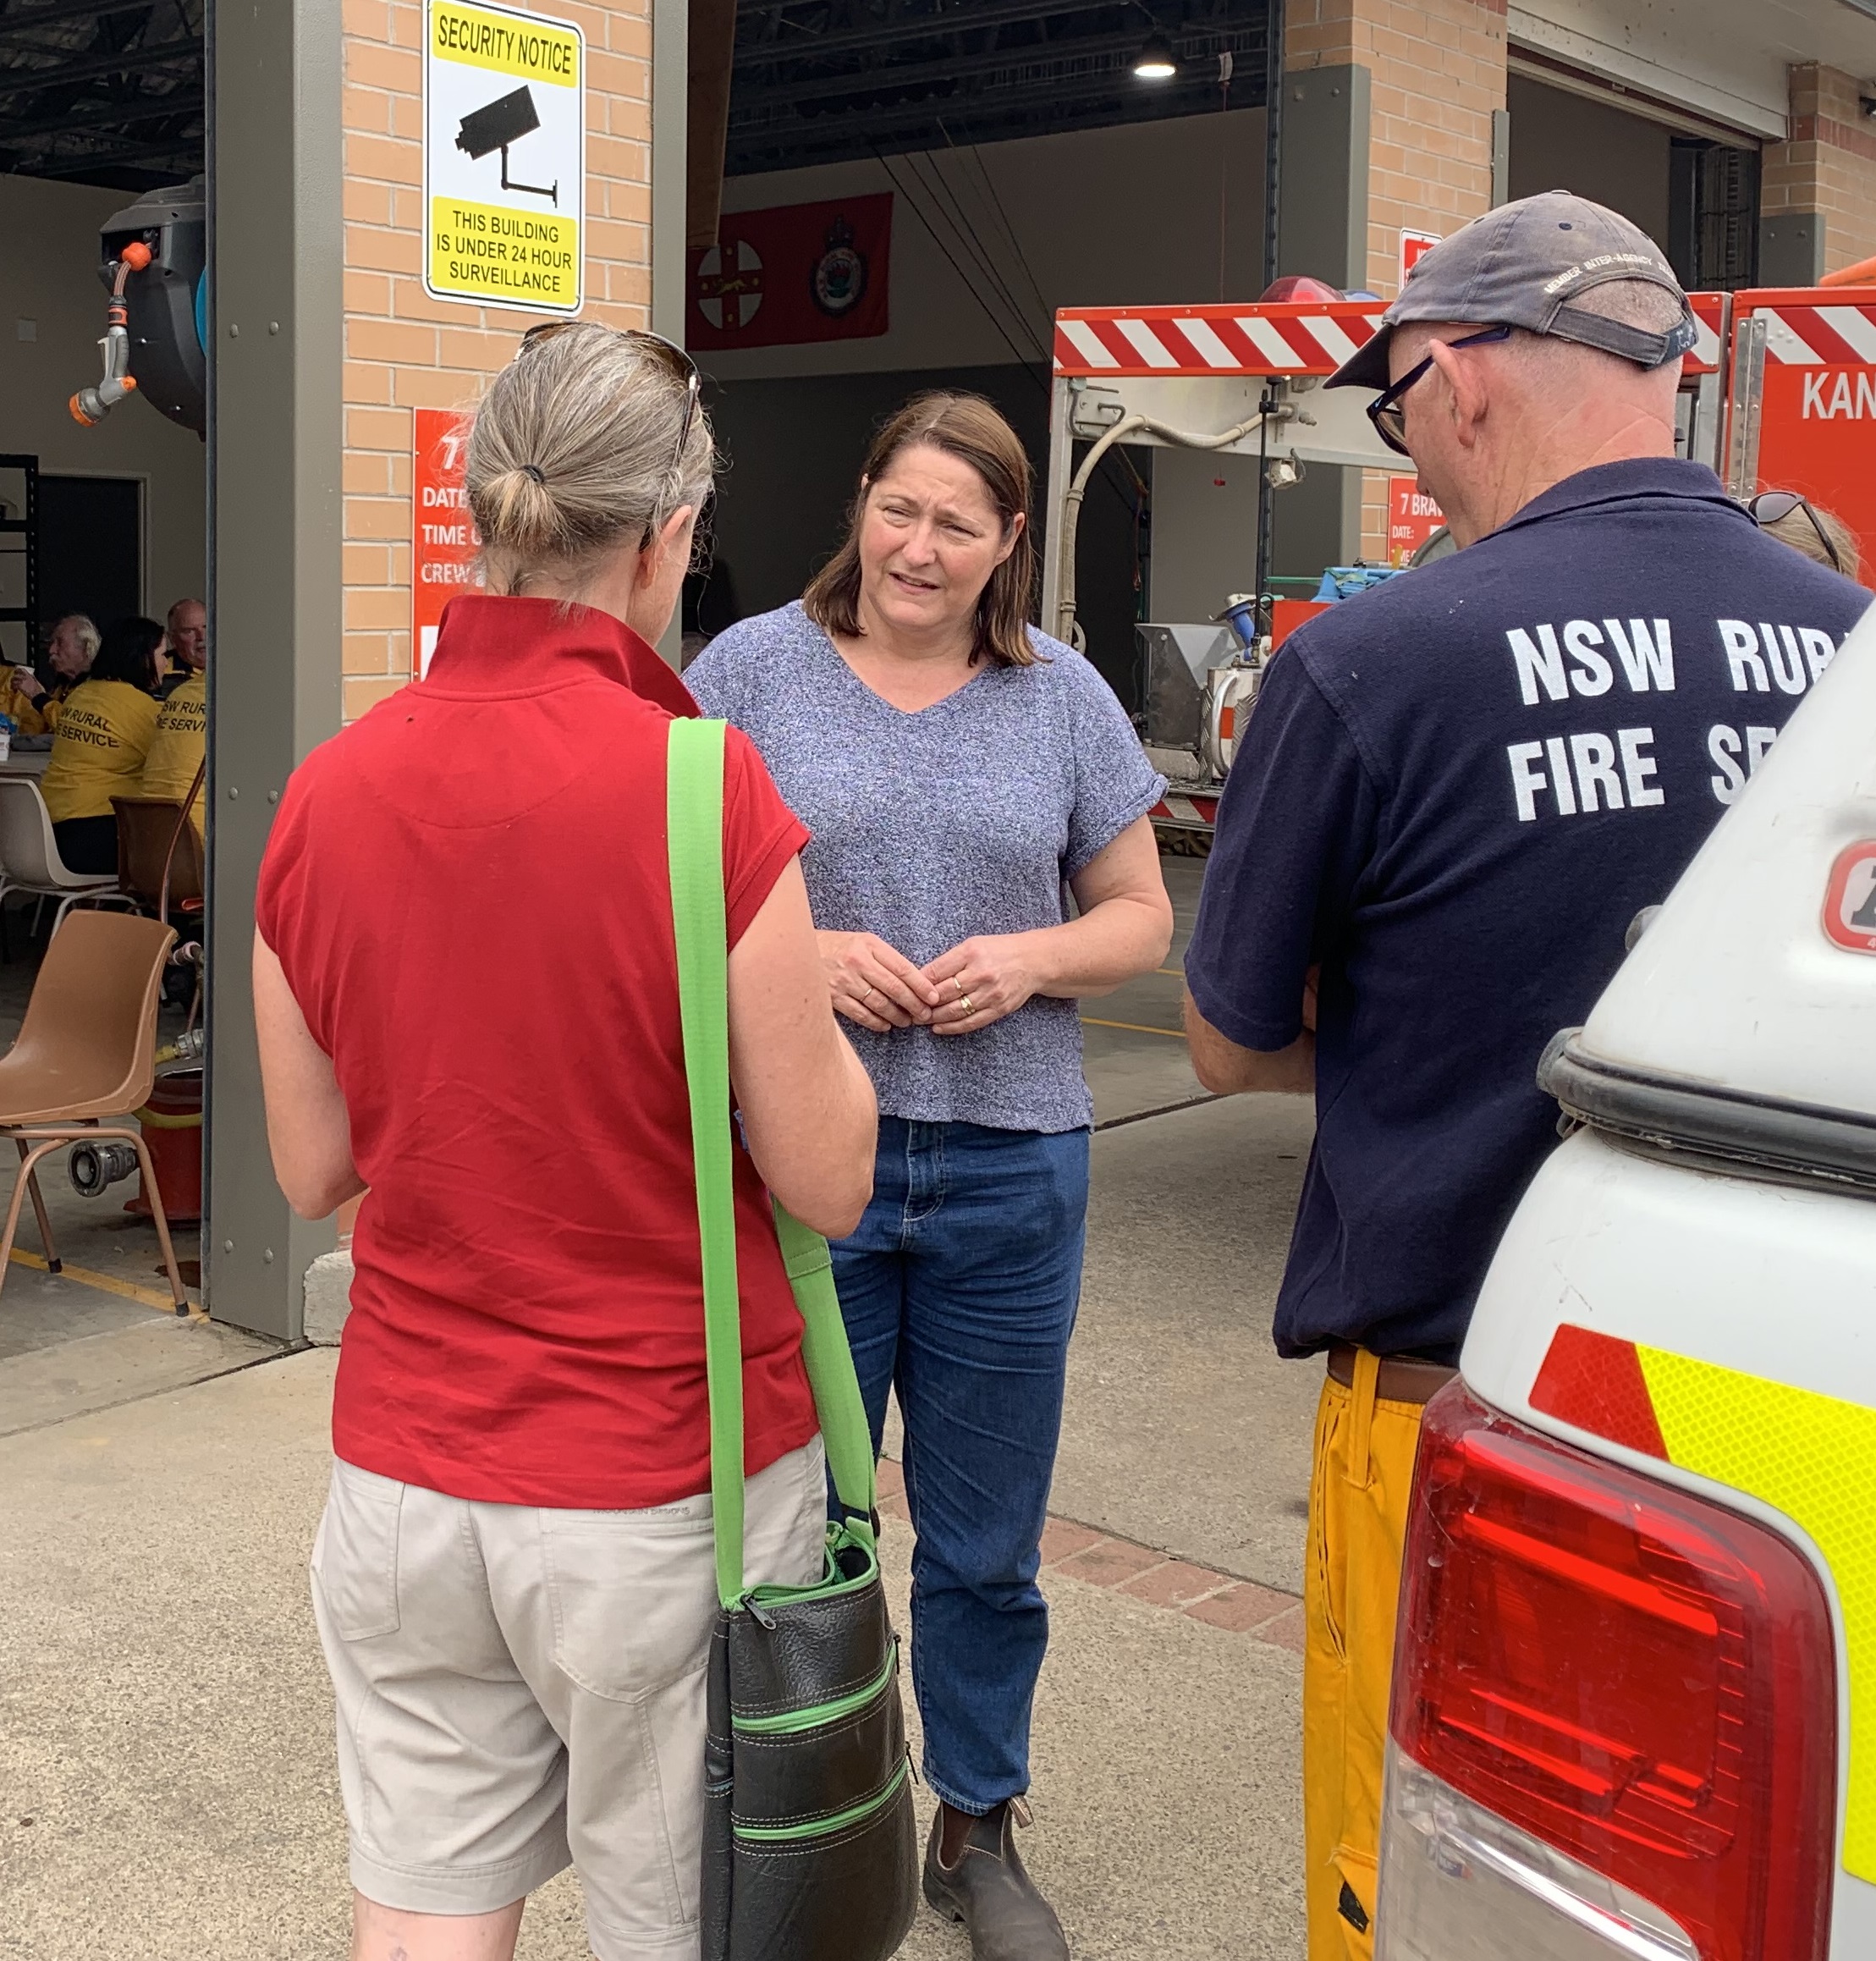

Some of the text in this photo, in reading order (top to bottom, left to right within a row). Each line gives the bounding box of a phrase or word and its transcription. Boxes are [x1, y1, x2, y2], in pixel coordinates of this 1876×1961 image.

[438, 14, 572, 75] SECURITY NOTICE
[453, 210, 559, 244] THIS BUILDING
[437, 234, 572, 270] IS UNDER 24 HOUR
[449, 261, 561, 293] SURVEILLANCE
[1543, 253, 1653, 294] MEMBER INTER-AGENCY
[1802, 372, 1876, 420] KAN
[1400, 493, 1410, 515] 7
[421, 524, 466, 546] TIME
[1392, 525, 1414, 540] DATE:
[421, 563, 470, 584] CREW
[1505, 619, 1851, 706] NSW RUR
[61, 725, 120, 748] SERVICE
[70, 709, 112, 733] RURAL
[1506, 728, 1665, 822] FIRE
